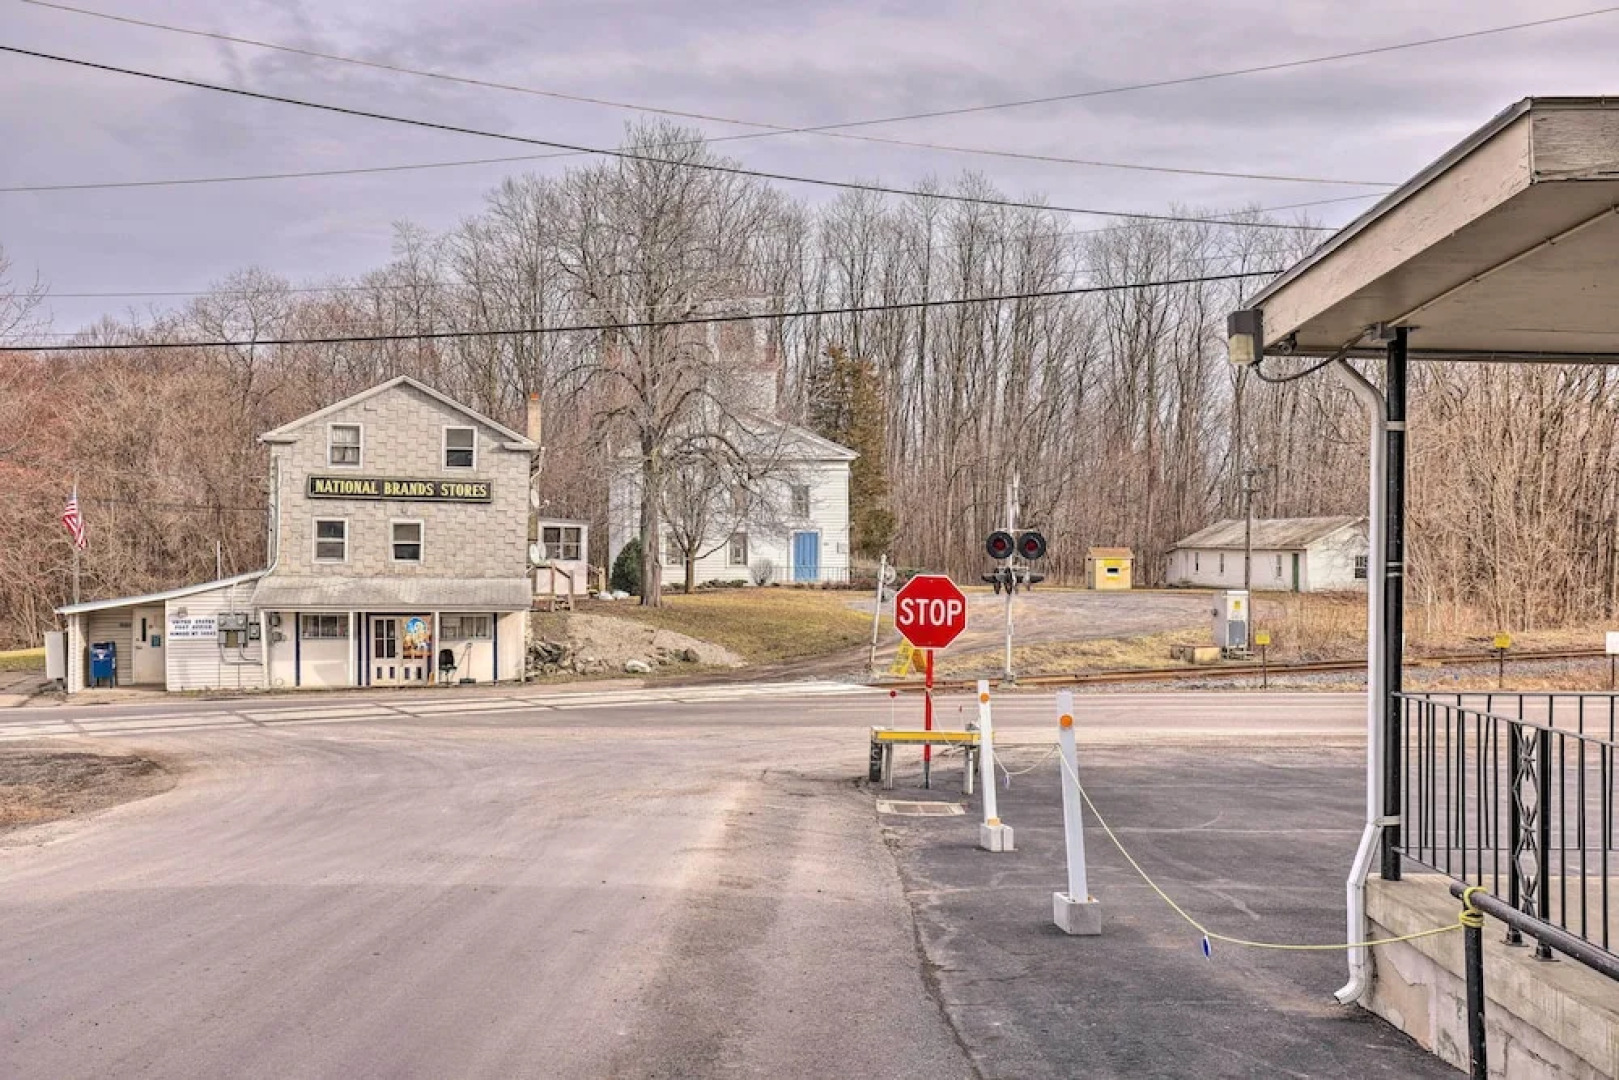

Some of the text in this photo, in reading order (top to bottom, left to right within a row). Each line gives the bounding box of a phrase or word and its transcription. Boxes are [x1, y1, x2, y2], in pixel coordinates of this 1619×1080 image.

[315, 479, 487, 497] NATIONAL BRANDS STORES
[899, 598, 963, 626] STOP
